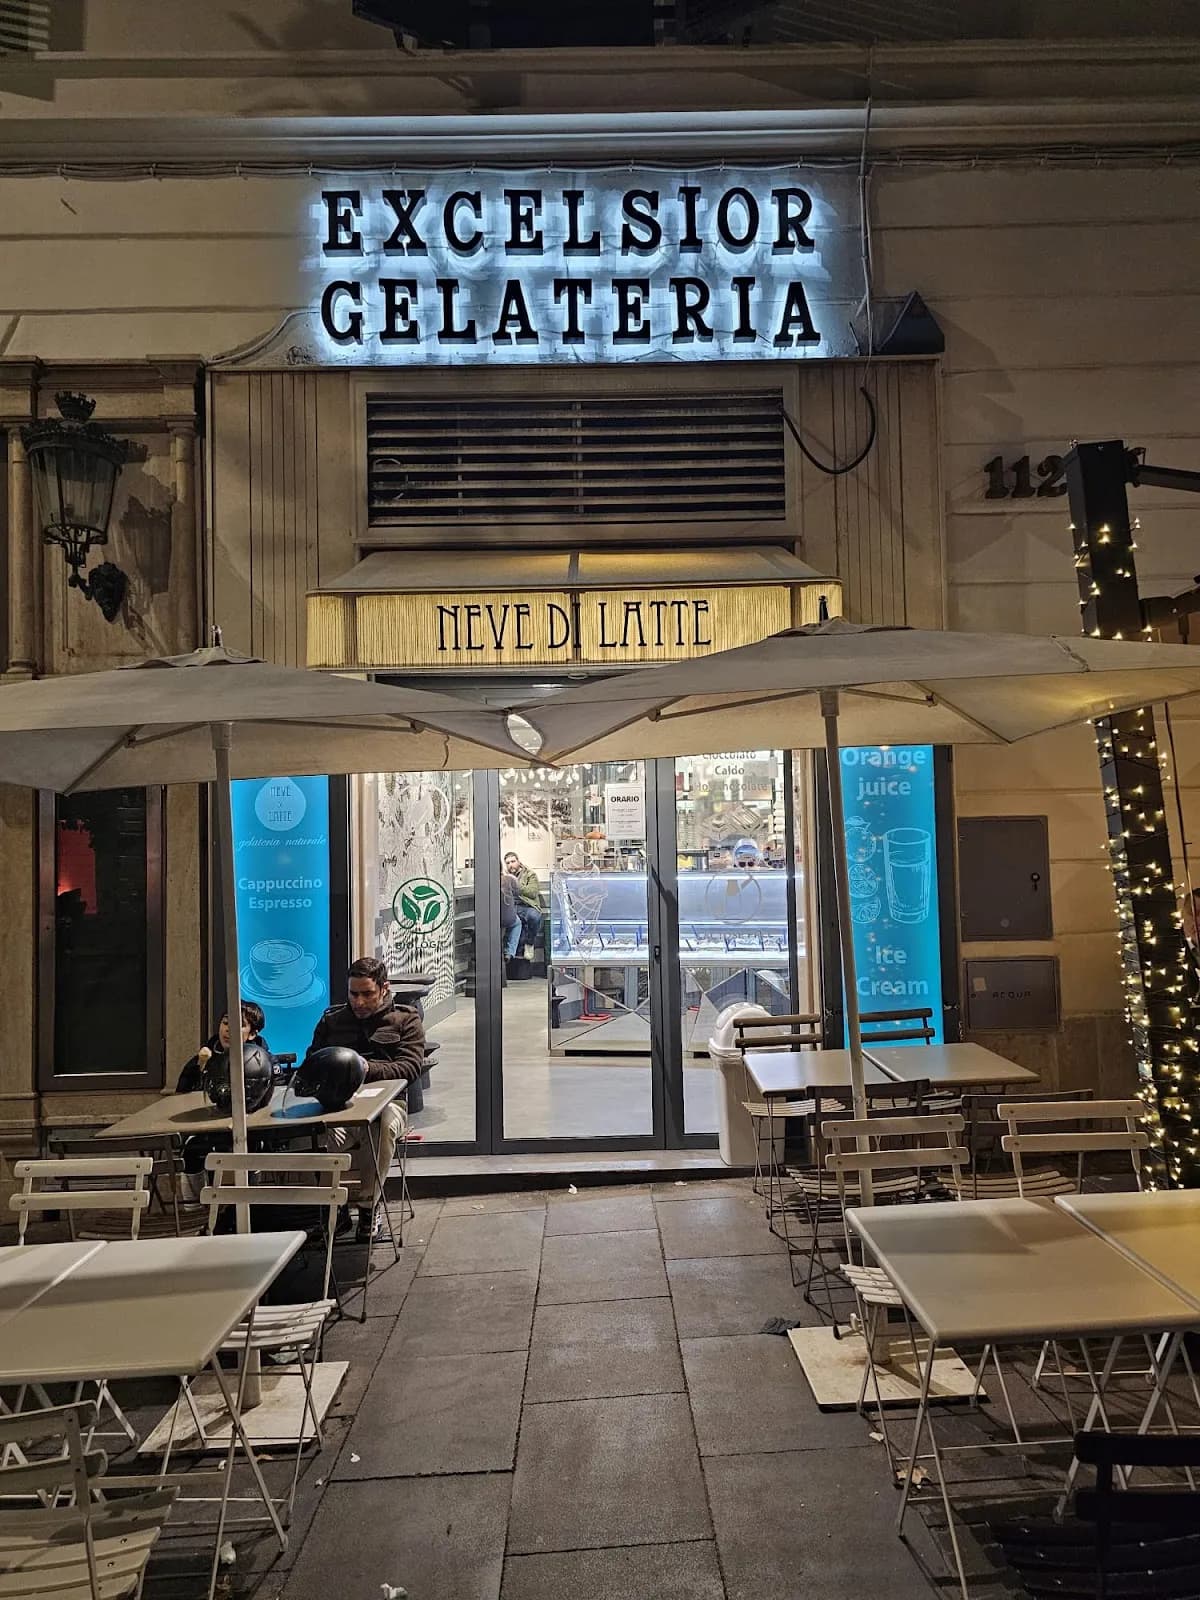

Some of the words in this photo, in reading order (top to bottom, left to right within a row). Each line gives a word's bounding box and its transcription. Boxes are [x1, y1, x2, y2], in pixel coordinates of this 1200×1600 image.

[320, 185, 817, 258] EXCELSIOR
[319, 276, 822, 348] GELATERIA
[984, 455, 1067, 499] 112
[437, 603, 534, 651] NEVE
[547, 601, 582, 650] DI
[598, 599, 712, 648] LATTE
[841, 748, 927, 771] Orange
[714, 765, 746, 776] Caldo
[855, 777, 912, 799] juice
[610, 795, 640, 803] ORARIO
[238, 876, 323, 894] Cappuccino
[248, 896, 312, 911] Espresso
[875, 945, 907, 965] Ice
[857, 977, 929, 997] Cream
